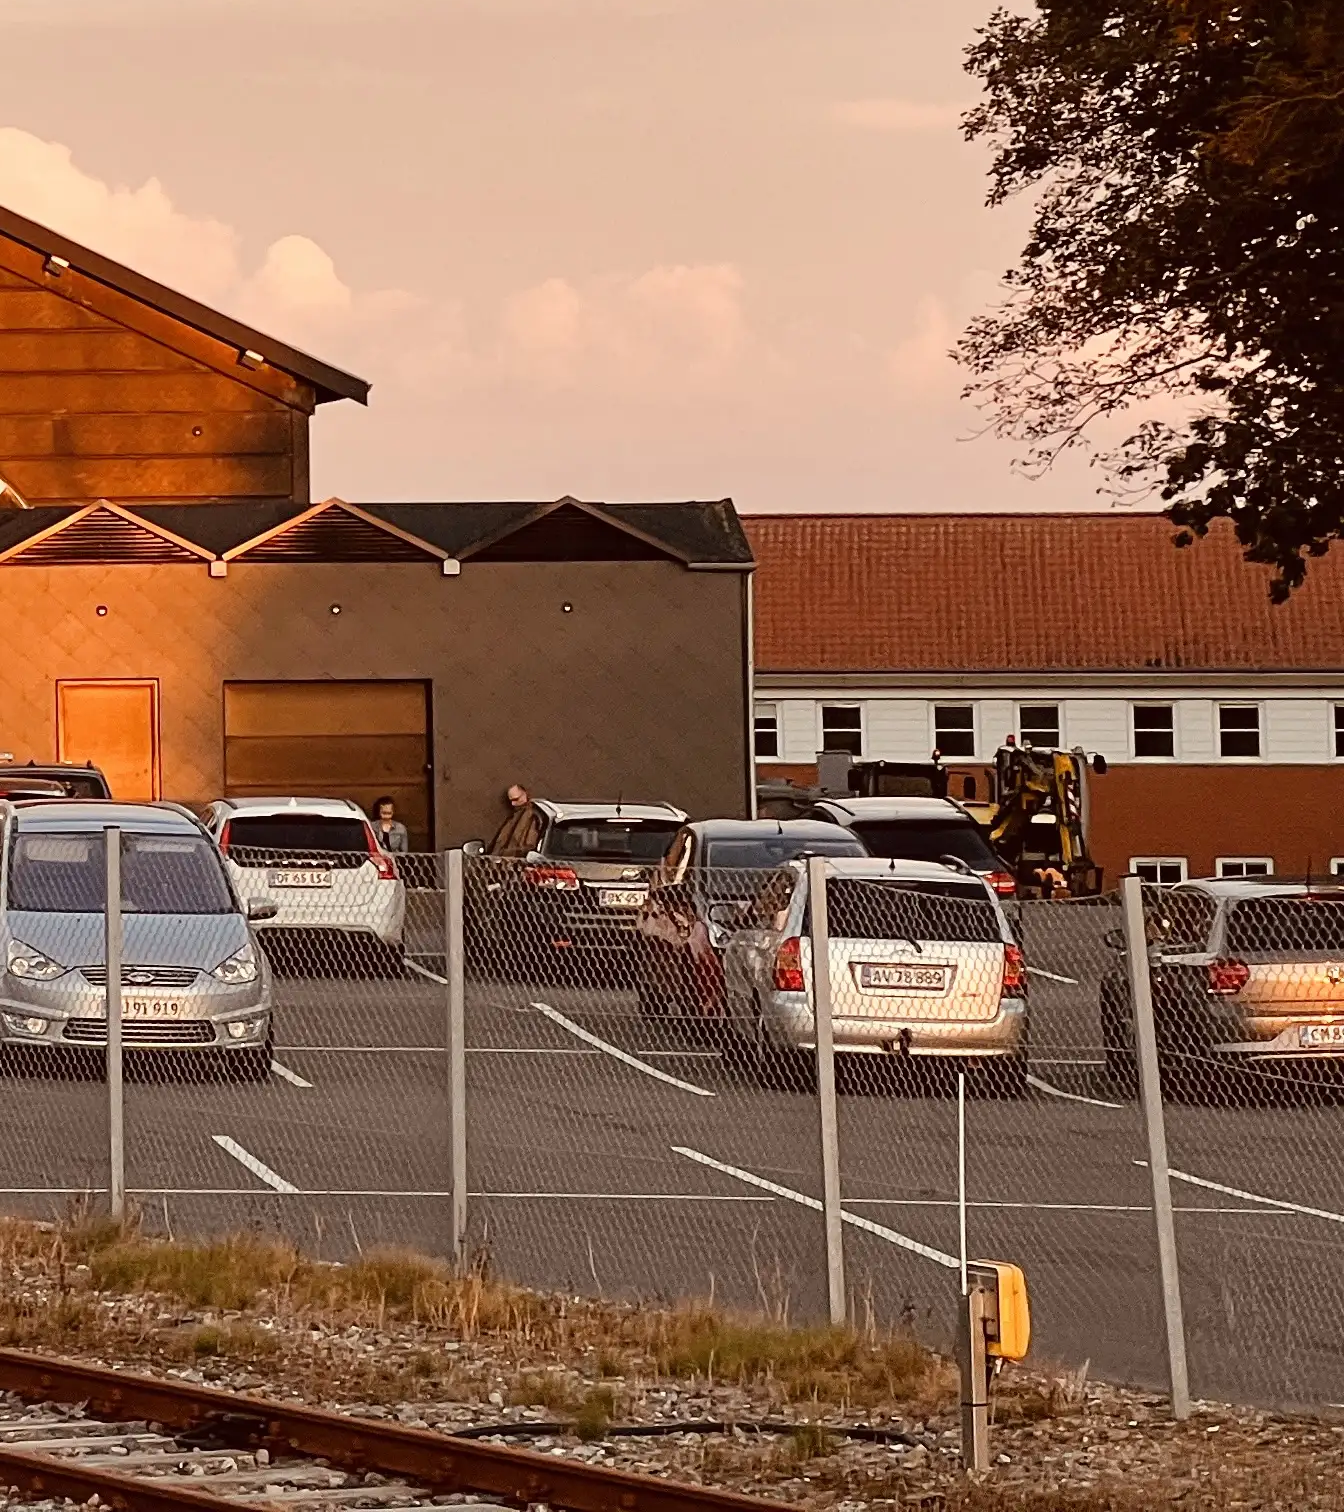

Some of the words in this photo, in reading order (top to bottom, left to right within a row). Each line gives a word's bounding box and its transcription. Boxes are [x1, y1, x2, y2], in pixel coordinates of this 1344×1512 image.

[872, 970, 892, 984] AV
[894, 970, 912, 984] 78
[914, 971, 943, 985] 889
[133, 1002, 148, 1016] 91
[153, 1002, 179, 1016] 919
